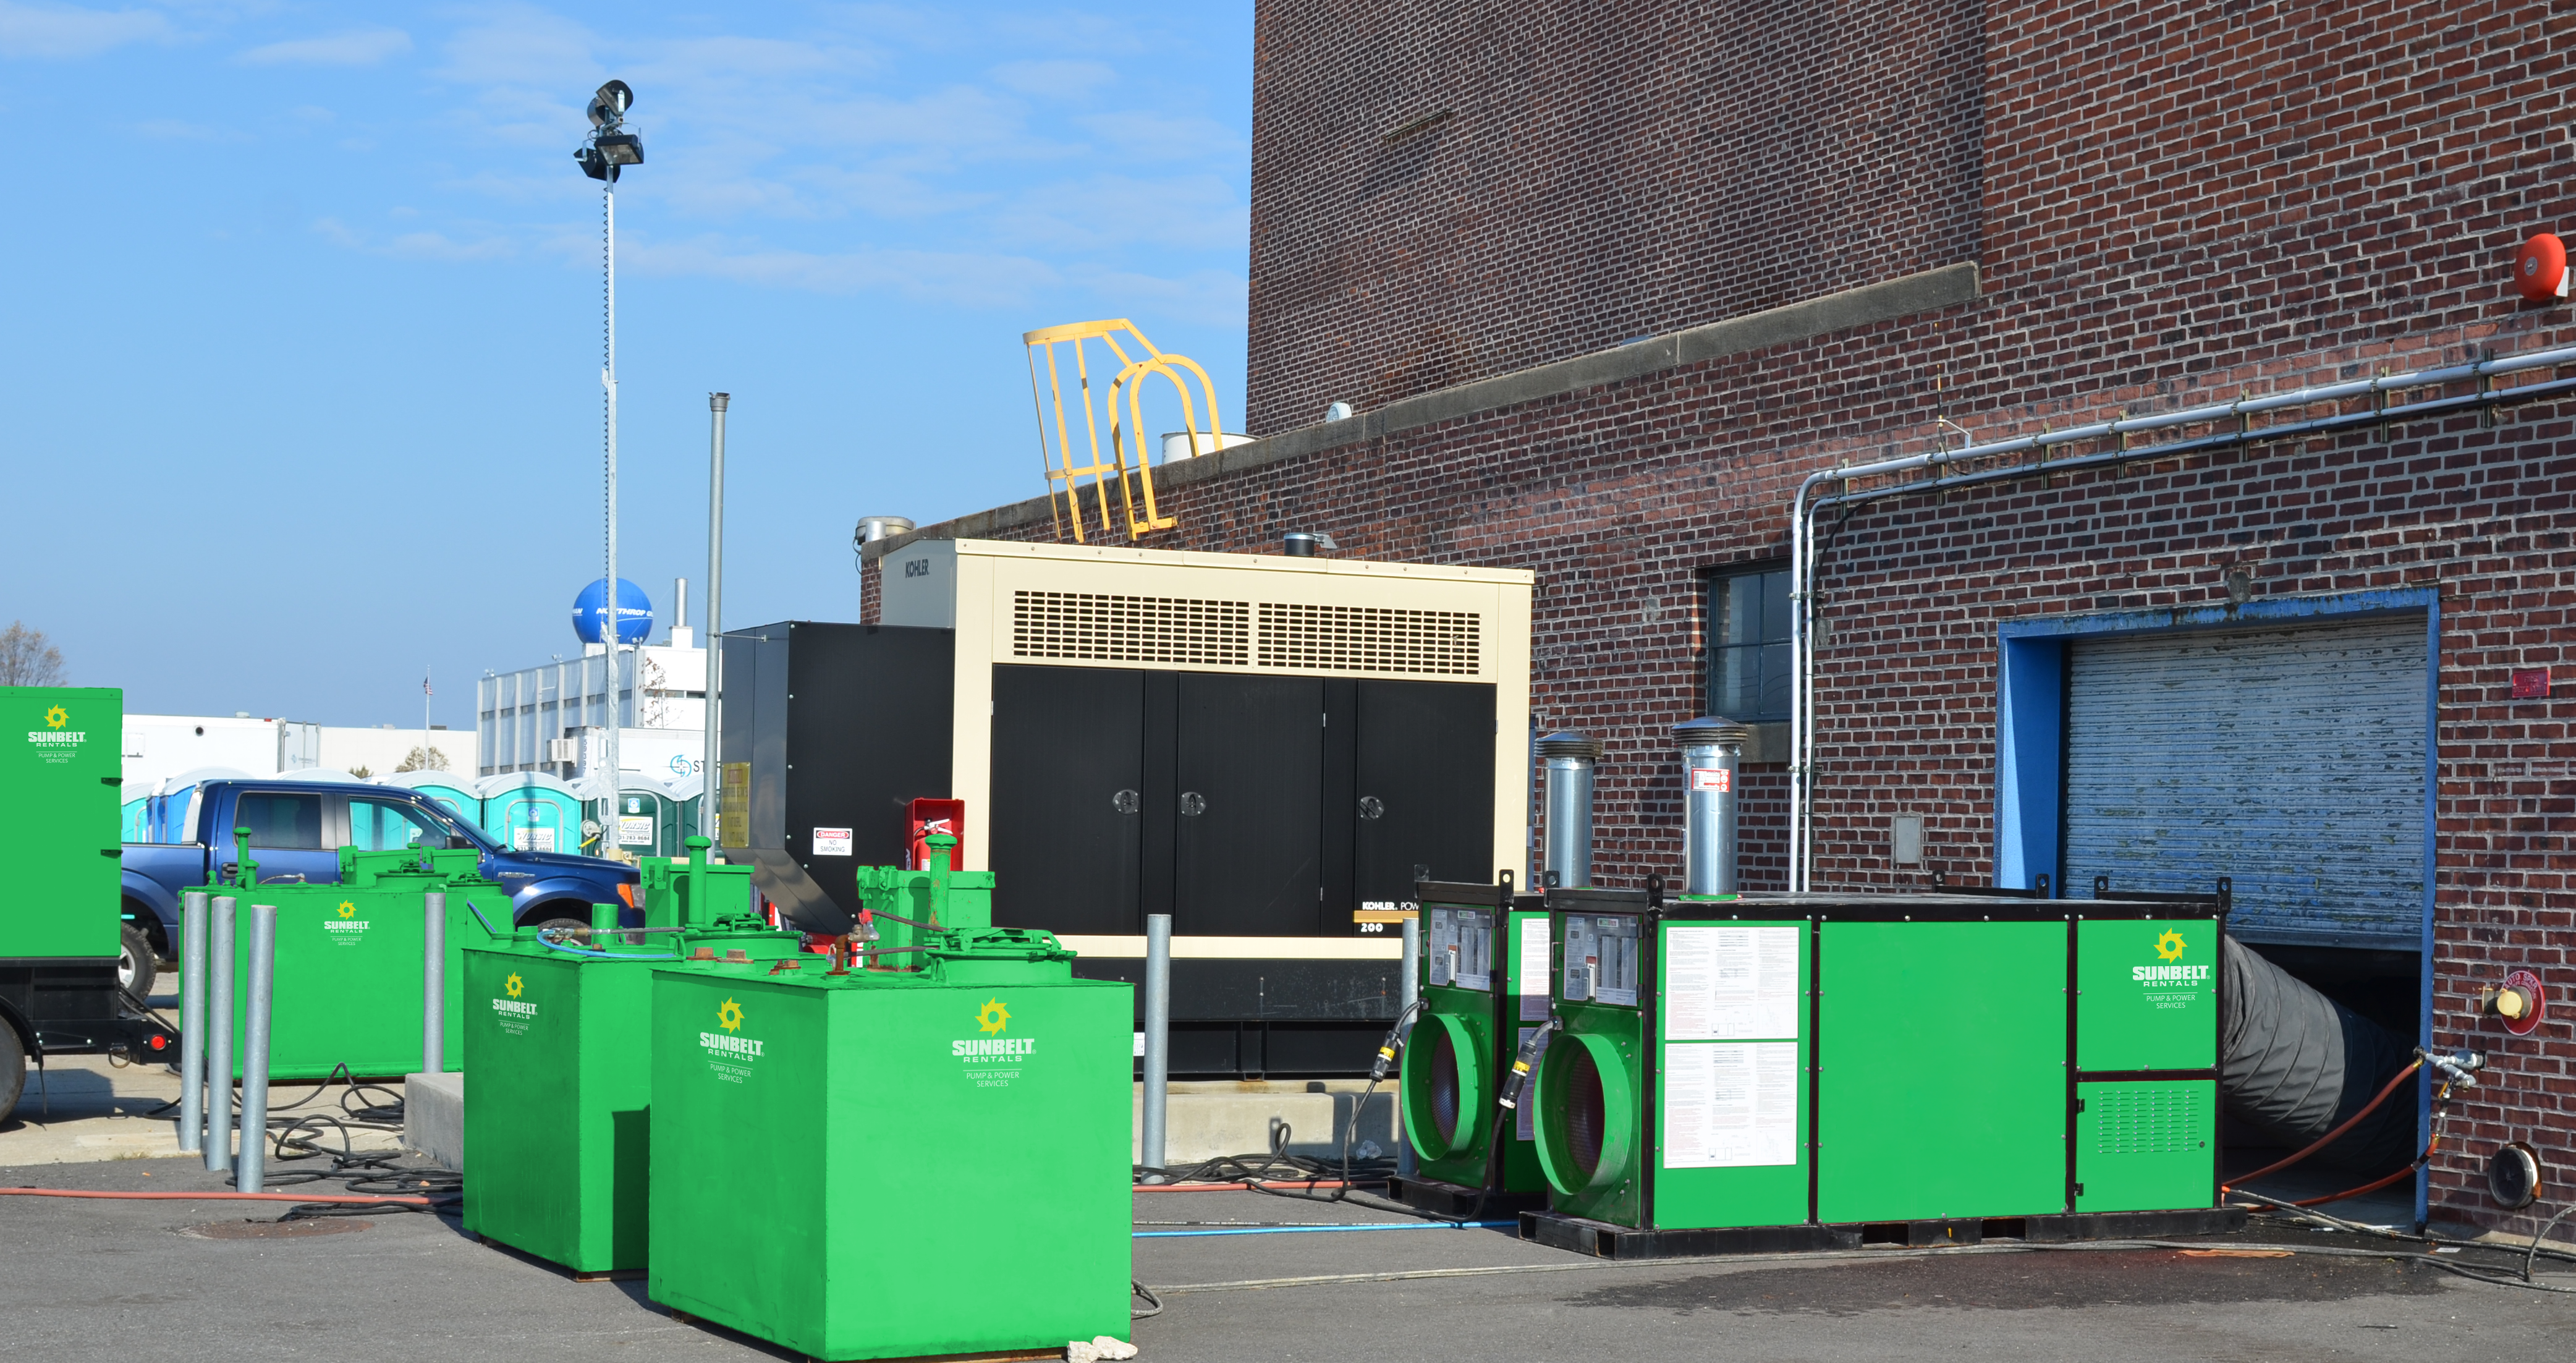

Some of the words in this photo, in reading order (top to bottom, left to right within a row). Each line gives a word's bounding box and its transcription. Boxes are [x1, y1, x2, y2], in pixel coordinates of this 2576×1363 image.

[905, 559, 929, 578] KOHLER
[596, 607, 646, 616] NOTHROP
[28, 731, 86, 742] SUNBELT
[1362, 901, 1396, 911] KOHLER
[1400, 902, 1419, 911] POW
[324, 920, 370, 930] SUNBELT
[1360, 923, 1384, 933] 200
[2132, 965, 2209, 981] SUNBELT
[2504, 973, 2520, 989] AUTO
[2523, 973, 2538, 988] SPKR
[493, 998, 537, 1015] SUNBELT
[498, 1011, 530, 1019] RENTALS
[700, 1032, 763, 1056] SUNBELT
[952, 1038, 1035, 1056] SUNBELT
[708, 1048, 753, 1062] RENTALS
[710, 1063, 726, 1072] PUMP
[731, 1068, 751, 1077] POWER
[718, 1072, 743, 1084] SERVICES
